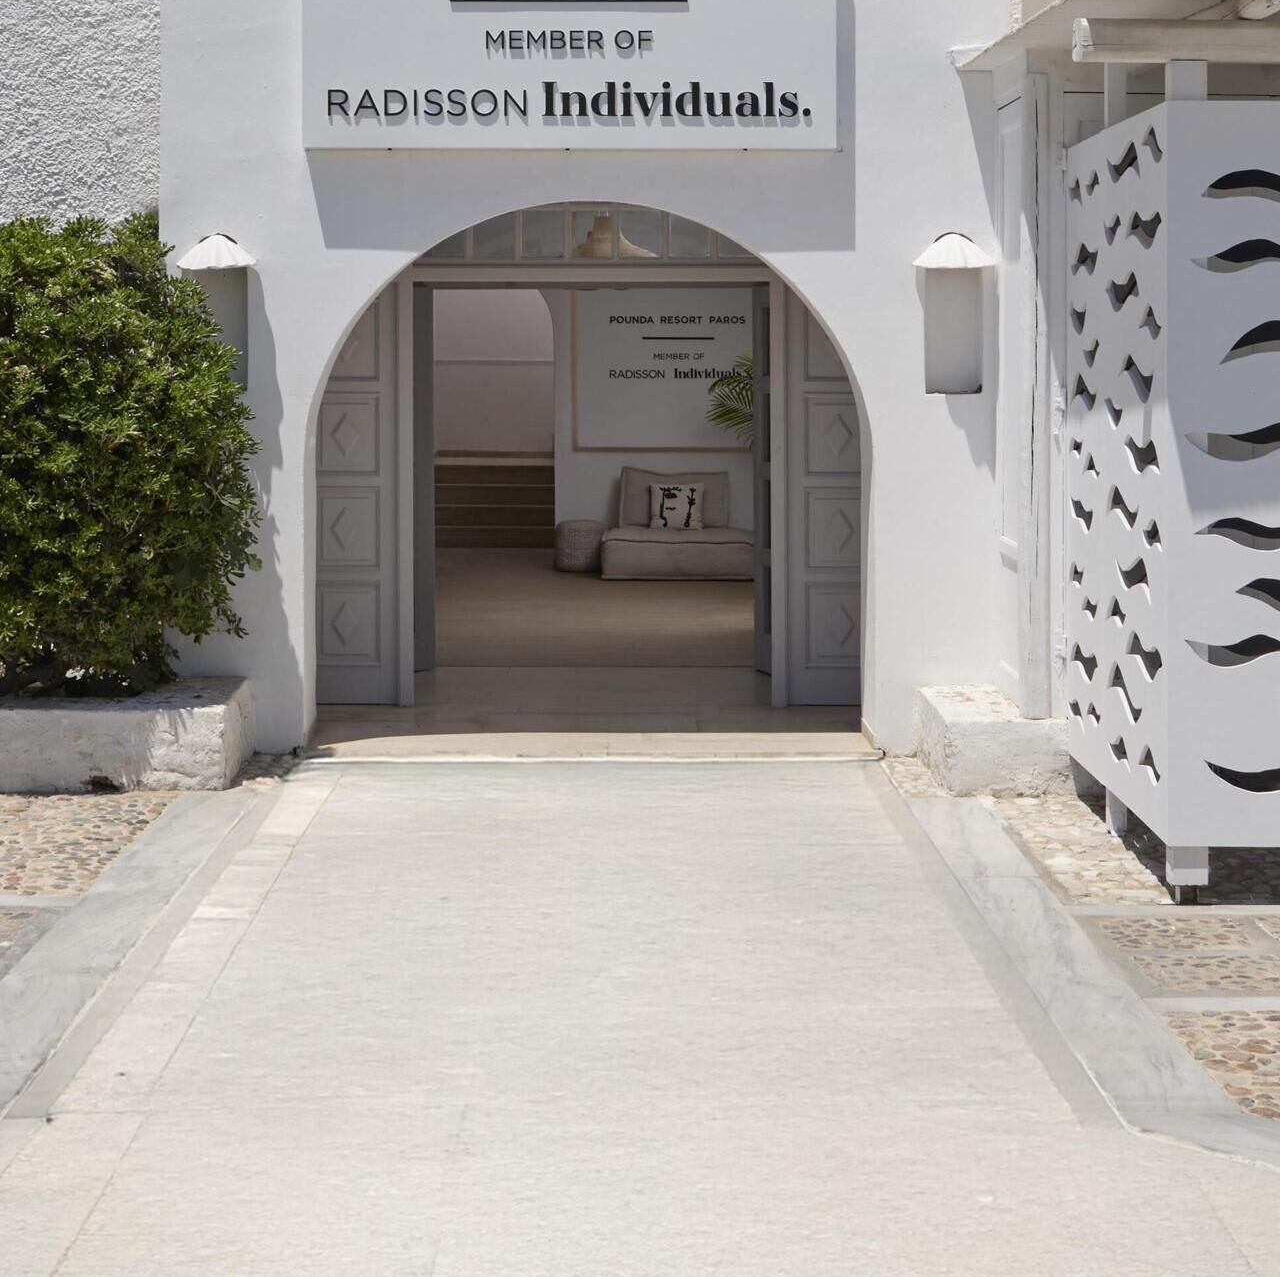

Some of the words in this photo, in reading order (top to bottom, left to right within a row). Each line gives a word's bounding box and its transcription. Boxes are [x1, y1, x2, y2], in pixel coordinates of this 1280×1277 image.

[485, 30, 604, 50] MEMBER
[615, 29, 653, 50] OF
[327, 89, 527, 117] RADISSON
[542, 81, 811, 118] Individuals.
[609, 315, 655, 324] POUNDA
[660, 315, 704, 324] RESORT
[709, 316, 746, 324] PAROS
[653, 352, 690, 361] MEMBER
[693, 352, 705, 361] OF
[608, 369, 666, 379] RADISSON
